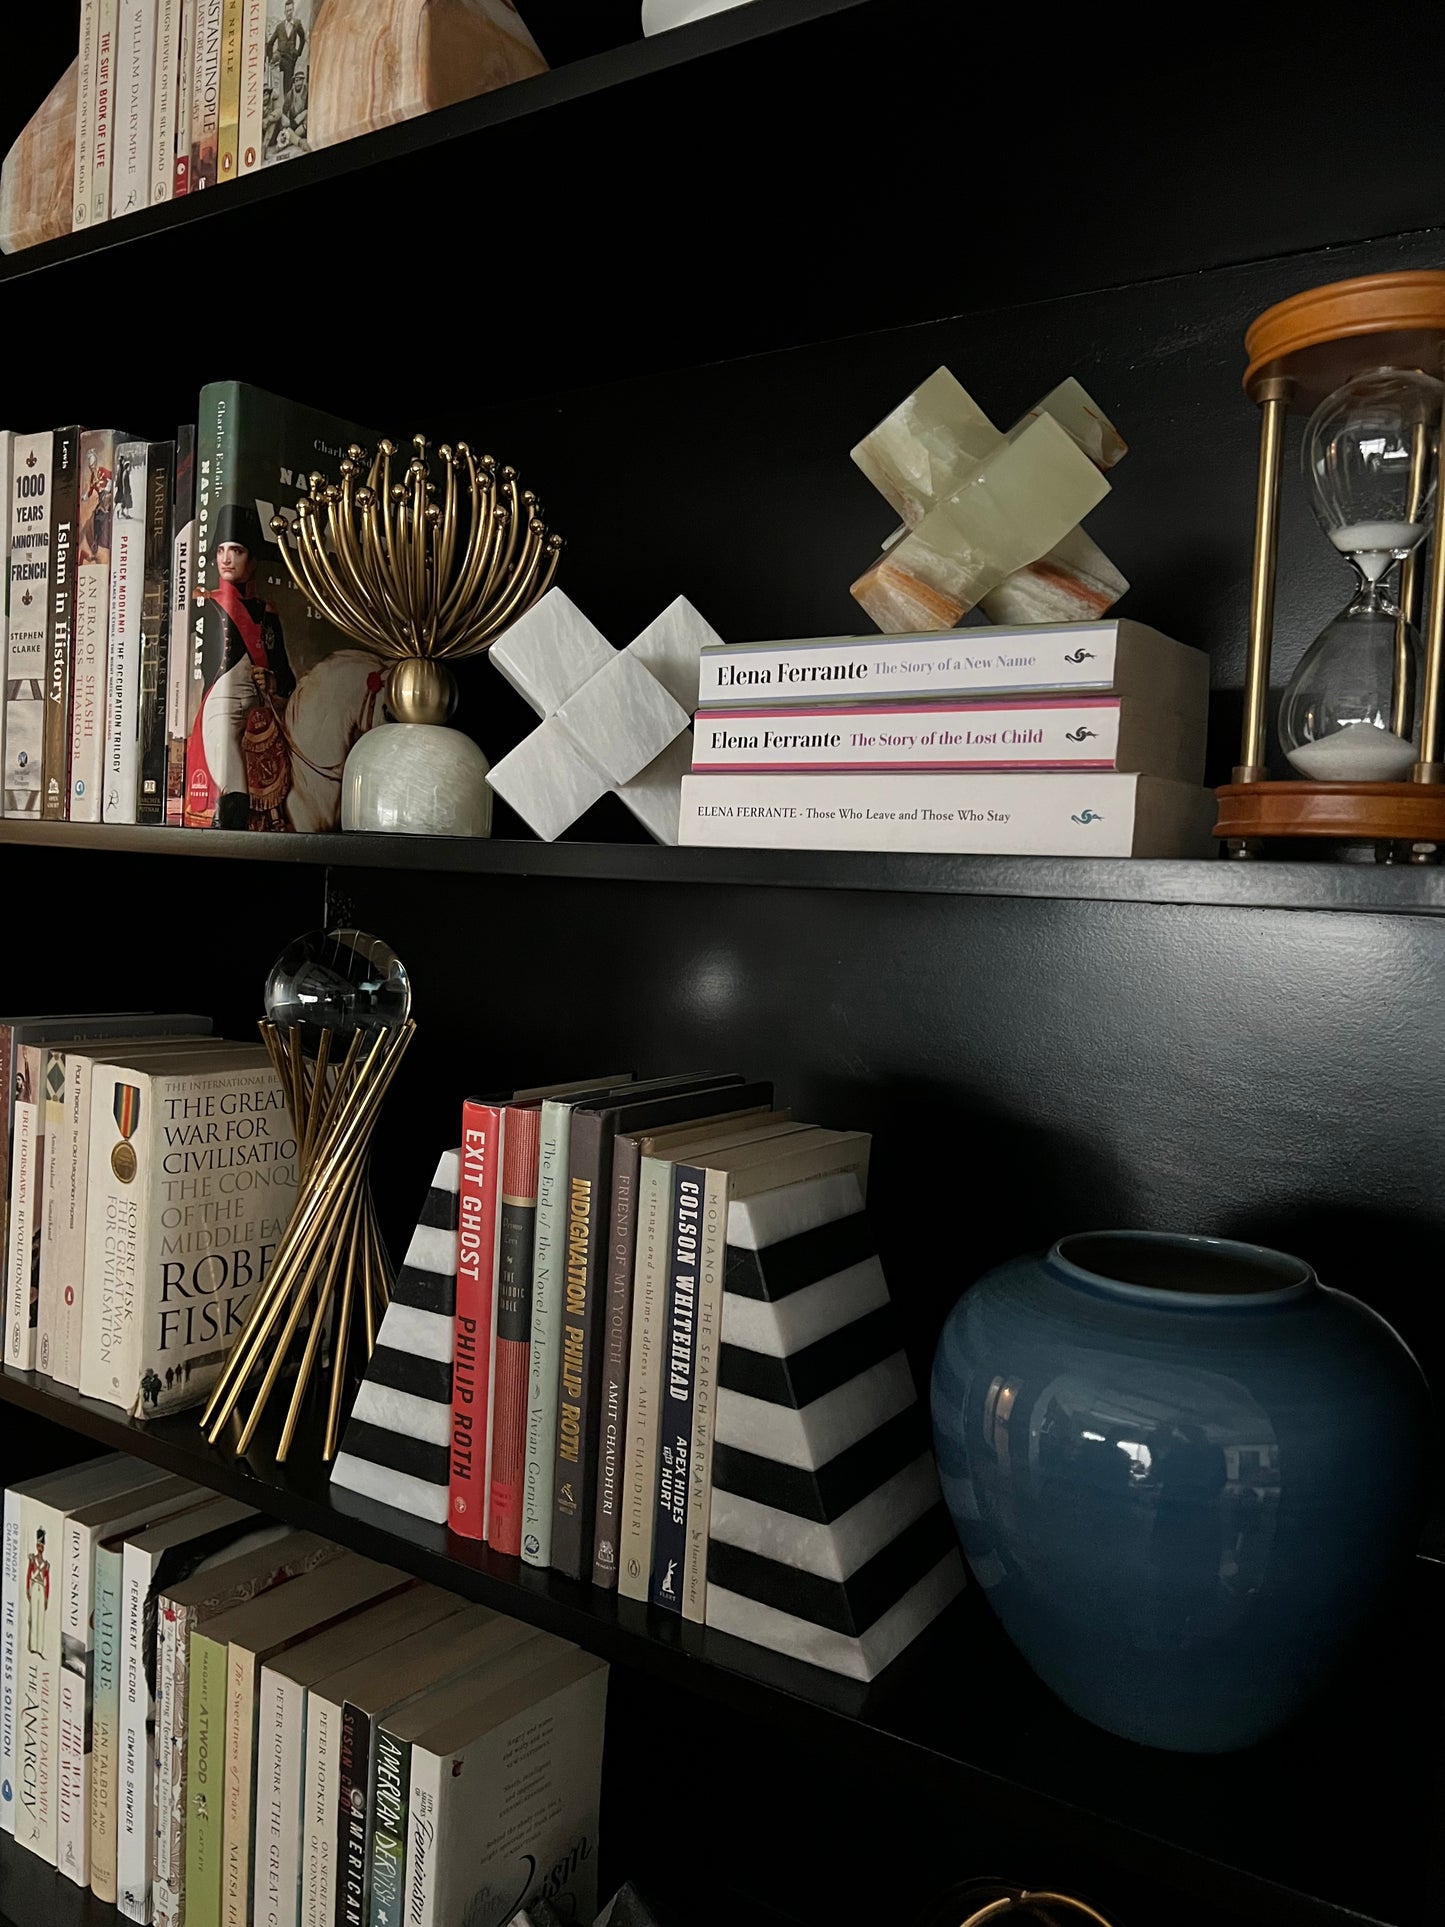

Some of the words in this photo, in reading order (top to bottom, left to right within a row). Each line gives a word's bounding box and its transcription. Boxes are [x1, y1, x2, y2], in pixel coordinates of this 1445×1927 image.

[101, 31, 111, 55] THE
[132, 9, 142, 78] WILLIAM
[162, 35, 170, 71] DEVILS
[100, 57, 109, 85] SUFI
[161, 73, 168, 91] ON
[246, 43, 258, 118] KHANNA
[98, 88, 108, 121] BOOK
[160, 91, 168, 113] THE
[97, 124, 106, 138] OF
[128, 83, 139, 175] DALRYMPLE
[96, 143, 105, 168] LIFE
[216, 400, 226, 450] Charles
[61, 440, 70, 470] Lewis
[213, 452, 225, 498] Esdaile
[16, 473, 46, 499] 1000
[153, 467, 166, 537] HARRER
[16, 505, 44, 523] YEARS
[196, 459, 211, 609] NAPOLEON'S
[11, 532, 49, 550] ANNOYING
[56, 521, 71, 585] Islam
[120, 536, 129, 581] PATRICK
[179, 541, 188, 557] IN
[11, 562, 48, 582] FRENCH
[88, 576, 98, 598] AN
[177, 559, 187, 611] LAHORE
[55, 592, 69, 614] in
[76, 576, 87, 665] DARKNESS
[87, 602, 97, 636] ERA
[117, 585, 127, 634] MODIANO
[10, 631, 44, 641] STEPHEN
[12, 644, 41, 654] CLARKE
[86, 642, 96, 665] OF
[117, 641, 125, 661] THE
[192, 616, 205, 681] WARS
[50, 621, 67, 704] History
[717, 665, 772, 686] Elena
[778, 661, 868, 683] Ferrante
[873, 661, 898, 675] The
[900, 660, 933, 676] Story
[938, 657, 953, 671] of
[953, 662, 961, 671] a
[964, 656, 994, 670] New
[996, 655, 1036, 667] Name
[73, 675, 83, 760] THAROOR
[83, 675, 95, 738] SHASHI
[115, 664, 124, 732] OCCUPATION
[112, 731, 121, 774] TRILOGY
[711, 731, 758, 749] Elena
[763, 730, 841, 749] Ferrante
[850, 733, 876, 746] The
[879, 733, 917, 750] Story
[921, 731, 937, 745] of
[938, 731, 963, 745] the
[966, 731, 997, 745] Lost
[1001, 729, 1044, 744] Child
[697, 806, 735, 818] ELENA
[736, 807, 798, 819] FERRANTE
[805, 808, 837, 820] Those
[838, 808, 863, 820] Who
[866, 809, 896, 821] Leave
[898, 809, 918, 821] and
[921, 809, 954, 822] Those
[957, 809, 984, 822] Who
[987, 810, 1011, 824] Stay
[74, 1064, 82, 1085] Paul
[165, 1082, 187, 1093] THE
[189, 1075, 266, 1091] INTERNATIONAL
[21, 1109, 29, 1139] ERIC
[165, 1096, 215, 1120] THE
[163, 1122, 221, 1147] WAR
[225, 1117, 270, 1141] FOR
[543, 1138, 557, 1170] The
[18, 1140, 28, 1204] HOBSBAWM
[463, 1129, 486, 1188] EXIT
[105, 1195, 118, 1233] FOR
[161, 1205, 195, 1229] OF
[198, 1197, 245, 1223] THE
[541, 1176, 555, 1208] End
[615, 1175, 631, 1238] FRIEND
[116, 1198, 129, 1236] THE
[125, 1201, 138, 1278] ROBERT
[459, 1195, 483, 1282] GHOST
[538, 1213, 551, 1230] of
[676, 1181, 700, 1266] COLSON
[704, 1194, 719, 1285] MODIANO
[14, 1209, 25, 1317] REVOLUTIONARIES
[114, 1239, 127, 1299] GREAT
[537, 1235, 551, 1261] the
[566, 1177, 592, 1316] INDIGNATION
[615, 1243, 627, 1267] OF
[100, 1236, 116, 1363] CIVILISATION
[123, 1281, 135, 1321] FISK
[534, 1267, 550, 1319] Novel
[613, 1273, 626, 1299] MY
[112, 1304, 125, 1346] WAR
[157, 1293, 252, 1352] FISK
[534, 1317, 547, 1335] of
[609, 1303, 625, 1366] YOUTH
[669, 1275, 695, 1402] WHITEHEAD
[701, 1302, 713, 1336] THE
[455, 1315, 477, 1405] PHILIP
[532, 1339, 547, 1379] Love
[561, 1324, 585, 1398] PHILIP
[698, 1343, 711, 1414] SEARCH
[607, 1380, 620, 1422] AMIT
[452, 1412, 474, 1481] ROTH
[528, 1407, 543, 1457] Vivian
[559, 1402, 581, 1463] ROTH
[675, 1435, 688, 1474] APEX
[602, 1424, 617, 1516] CHAUDHURI
[692, 1423, 708, 1510] WARRANT
[525, 1461, 541, 1525] Gornick
[672, 1476, 687, 1525] HIDES
[72, 1530, 81, 1562] RON
[6, 1601, 15, 1627] THE
[70, 1563, 81, 1628] SUSKIND
[129, 1579, 139, 1650] PERMANENT
[4, 1632, 14, 1681] STRESS
[101, 1589, 114, 1692] LAHORE
[28, 1664, 38, 1694] THE
[127, 1655, 137, 1704] RECORD
[3, 1687, 13, 1758] SOLUTION
[274, 1687, 285, 1729] PETER
[20, 1692, 40, 1821] ANARCHY
[100, 1720, 109, 1748] IAN
[126, 1727, 136, 1775] EDWARD
[198, 1703, 209, 1785] ATWOOD
[317, 1711, 328, 1757] PETER
[99, 1752, 109, 1808] TALBOT
[272, 1733, 284, 1794] HOPKIRK
[125, 1780, 136, 1835] SNOWDEN
[315, 1760, 327, 1825] HOPKIRK
[98, 1813, 109, 1836] AND
[269, 1800, 283, 1839] THE
[267, 1843, 281, 1908] GREAT
[409, 1811, 435, 1926] Feminism
